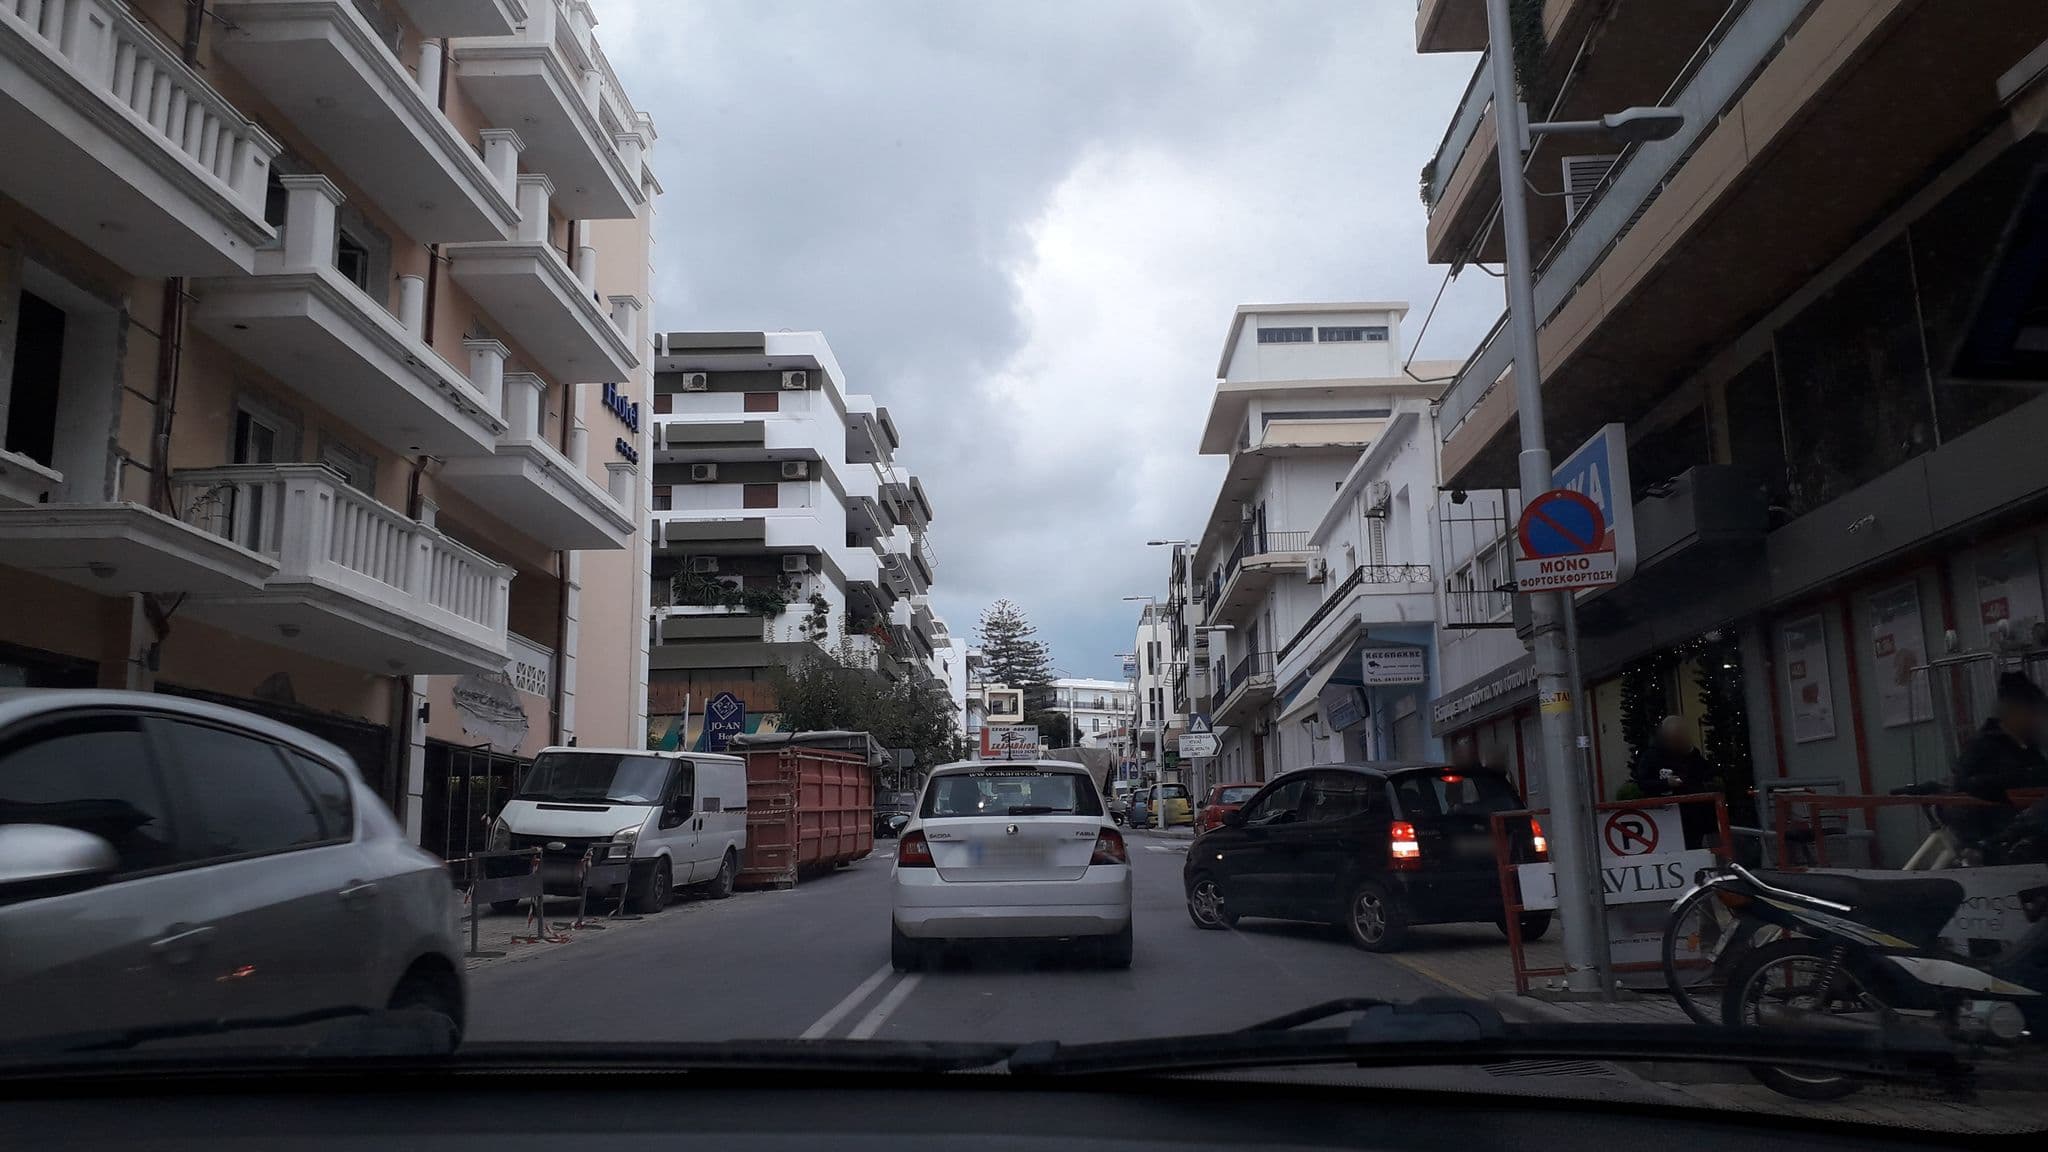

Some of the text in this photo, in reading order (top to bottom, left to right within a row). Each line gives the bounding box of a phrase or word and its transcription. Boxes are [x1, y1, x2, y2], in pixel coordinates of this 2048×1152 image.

[1539, 557, 1590, 574] ΜΟΝΟ
[1520, 570, 1613, 587] ΦΟΡΤΟΕΚΦΟΡΤΩΣΗ
[711, 721, 741, 731] JO-AN
